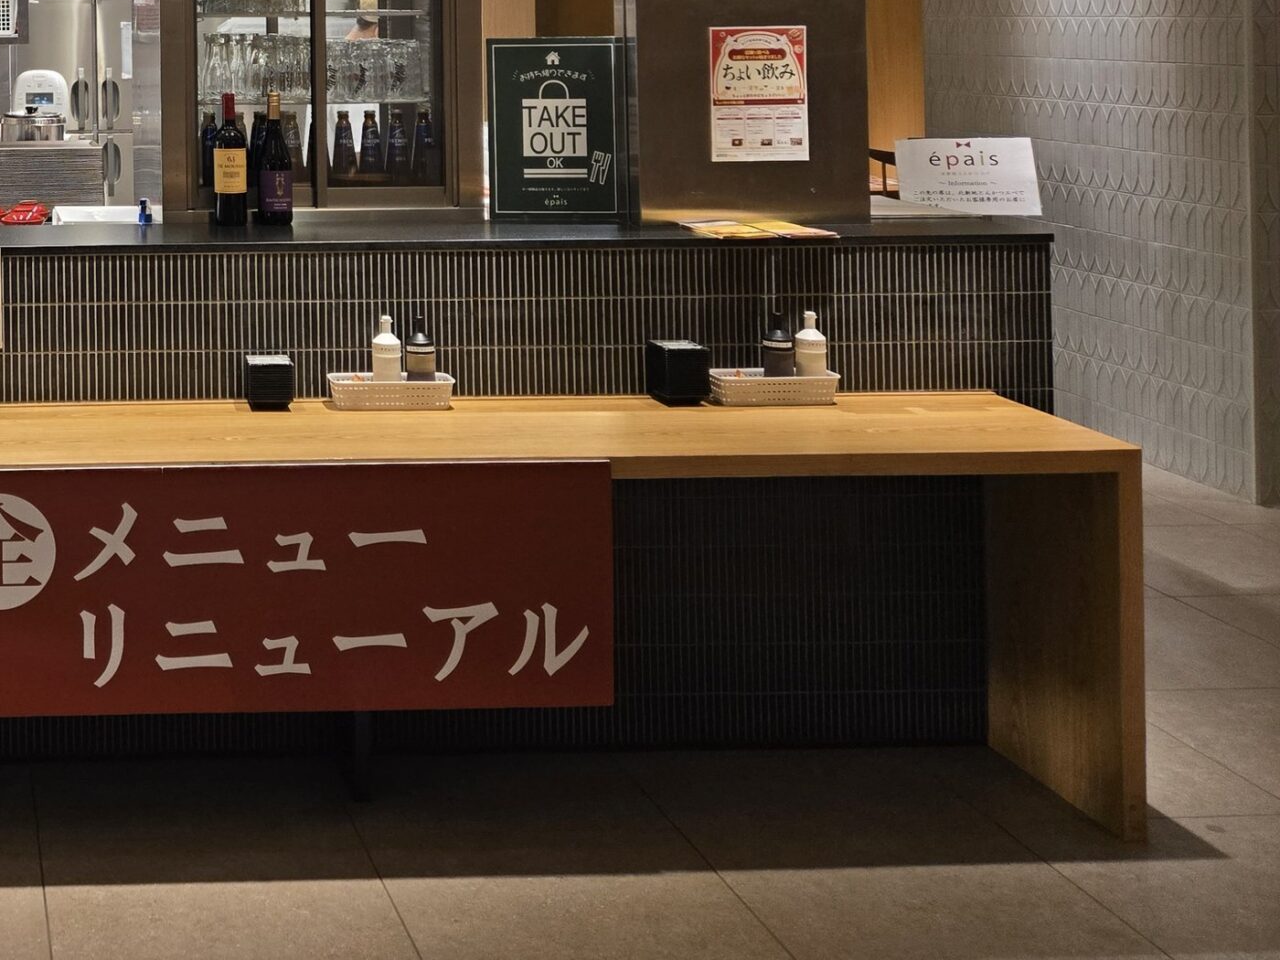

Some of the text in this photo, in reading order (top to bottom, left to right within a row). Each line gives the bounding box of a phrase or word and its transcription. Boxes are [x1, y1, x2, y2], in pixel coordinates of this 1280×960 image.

[722, 63, 796, 81] ちょい飲み
[522, 105, 587, 128] TAKE
[530, 132, 582, 155] OUT
[546, 157, 564, 168] OK
[929, 150, 999, 170] épais
[73, 501, 429, 583] メニュー
[79, 601, 590, 690] リニューアル
